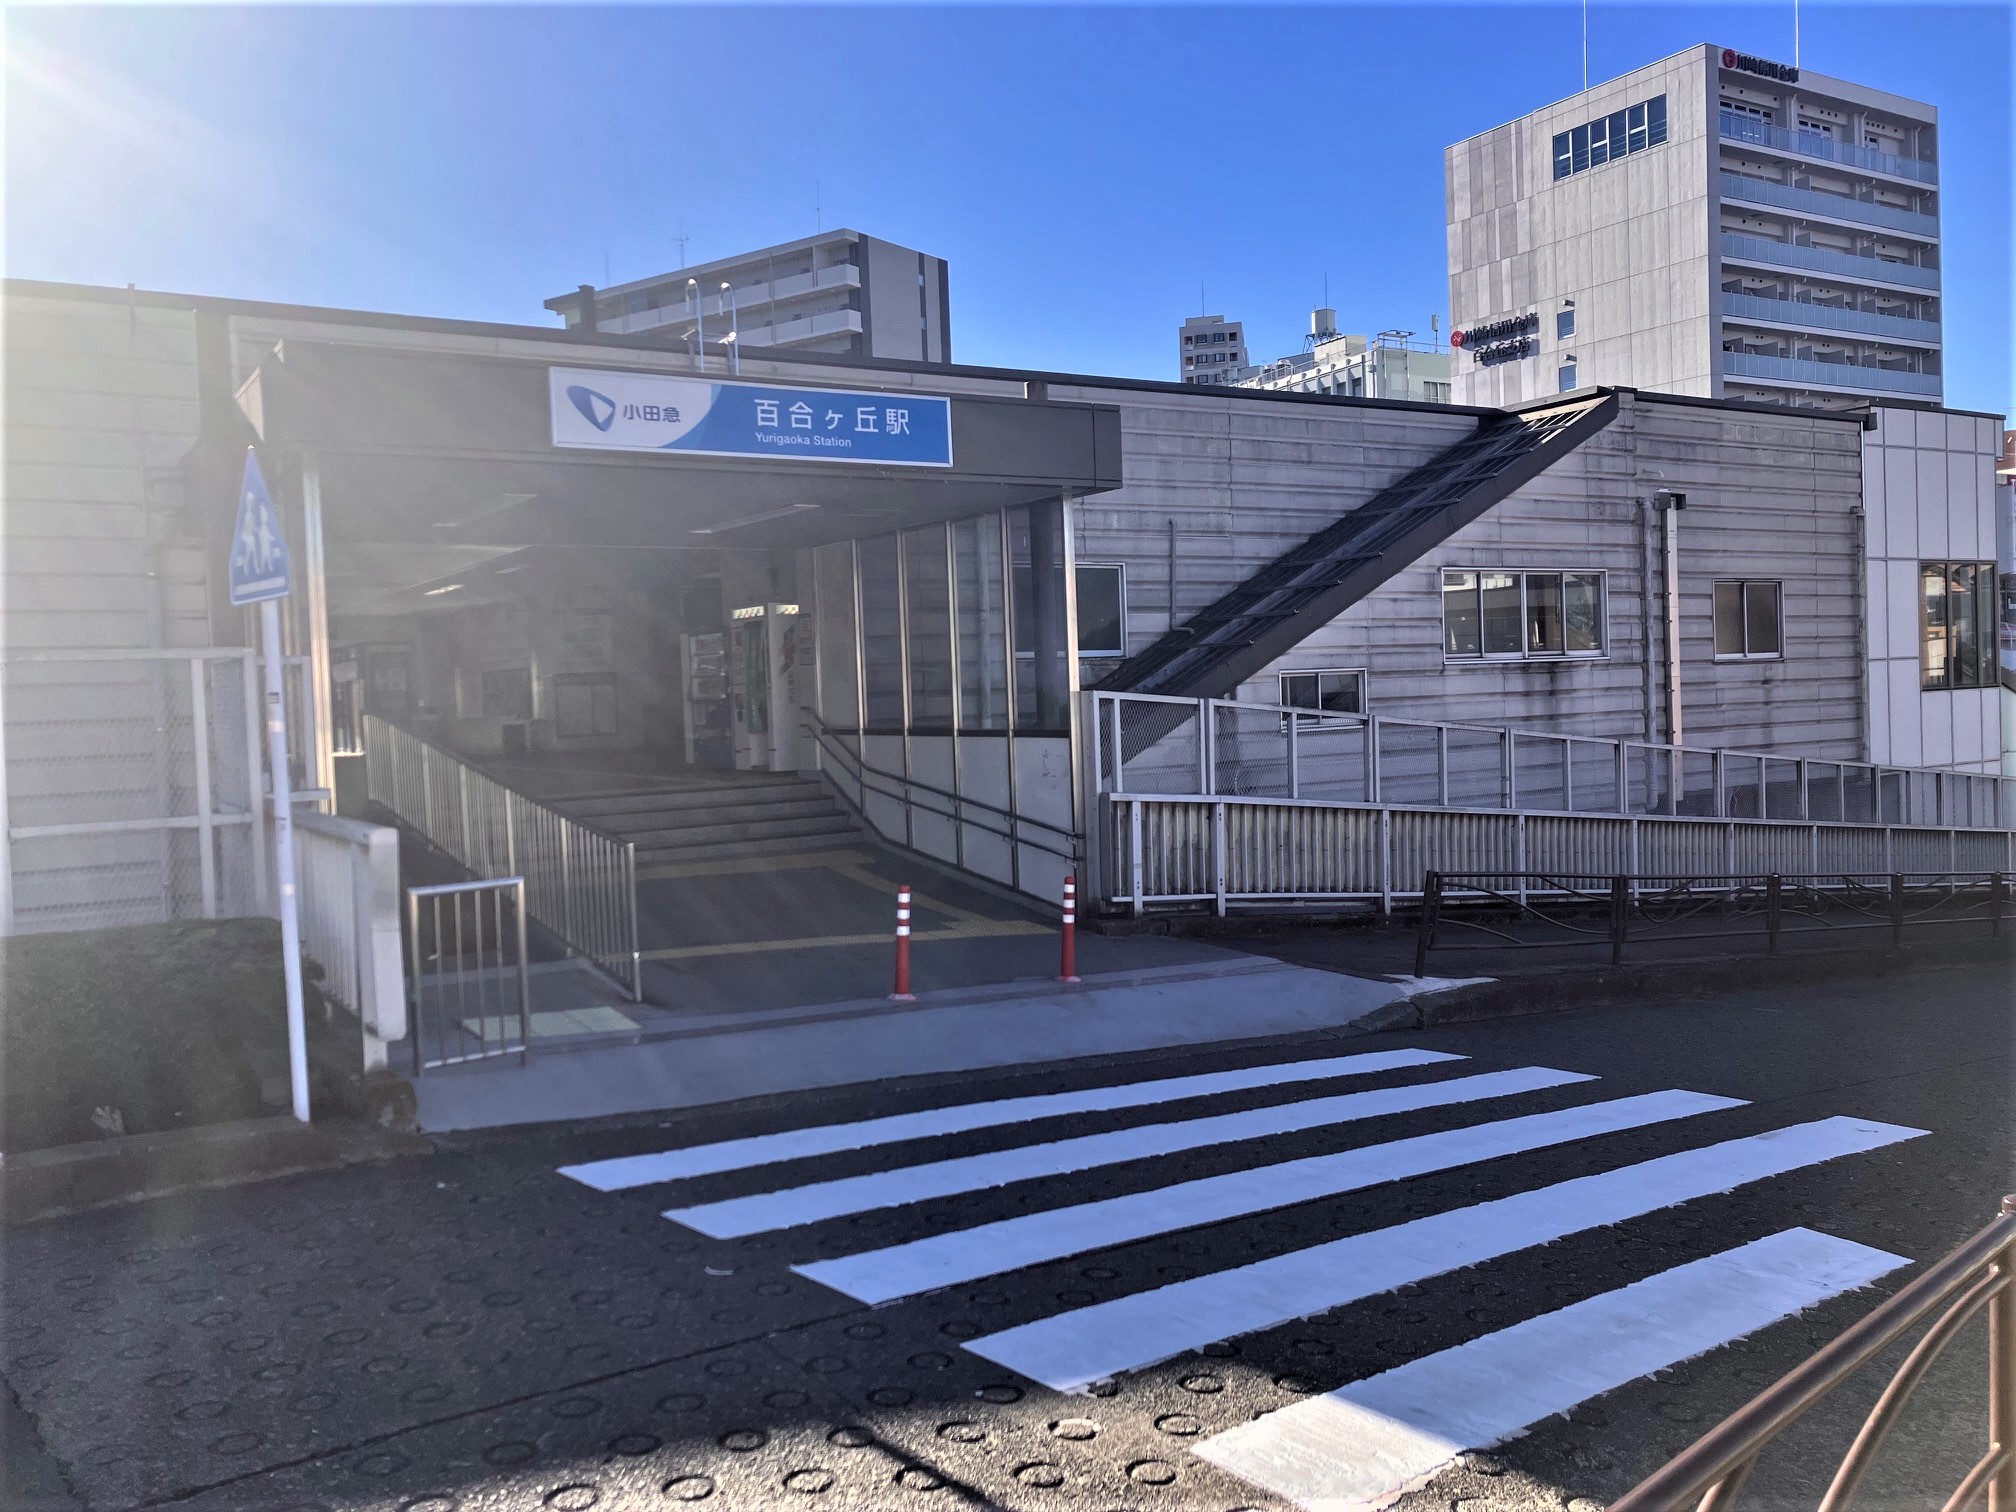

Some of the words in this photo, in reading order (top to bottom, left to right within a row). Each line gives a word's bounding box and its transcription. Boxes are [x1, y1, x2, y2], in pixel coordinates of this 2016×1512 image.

[622, 403, 682, 424] 小田急
[755, 432, 811, 447] Yurigaoka
[813, 434, 852, 448] Station
